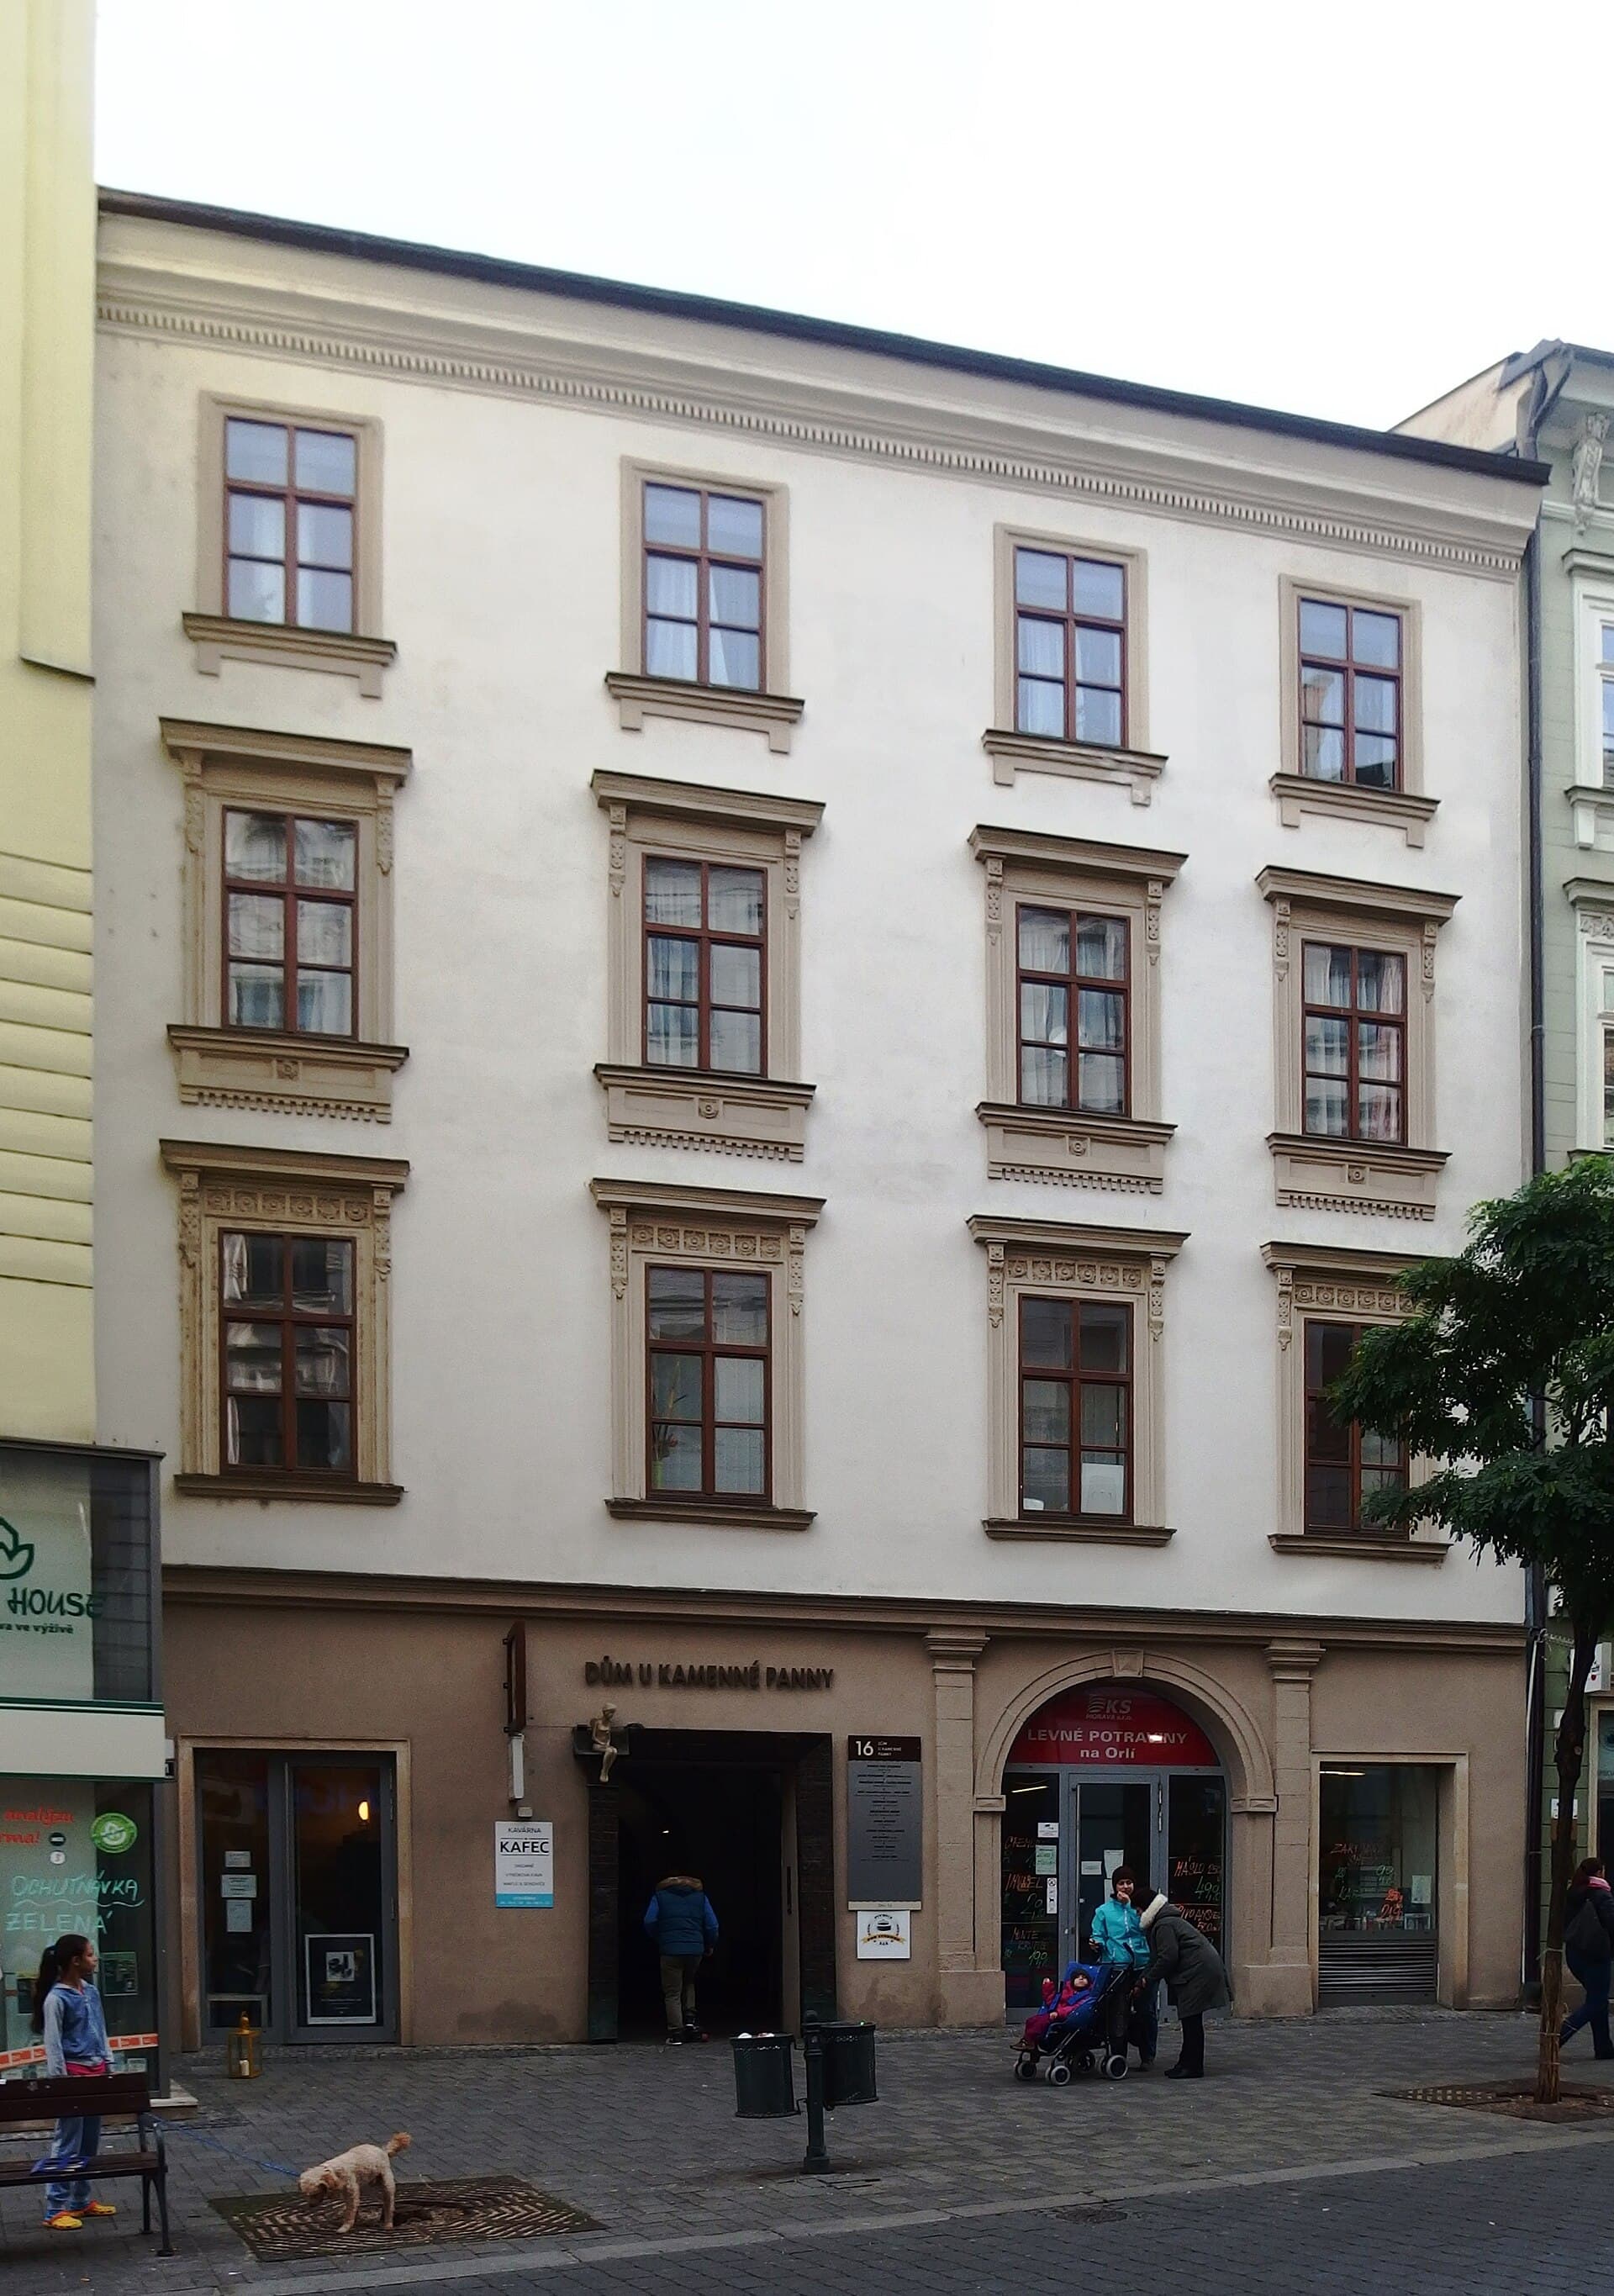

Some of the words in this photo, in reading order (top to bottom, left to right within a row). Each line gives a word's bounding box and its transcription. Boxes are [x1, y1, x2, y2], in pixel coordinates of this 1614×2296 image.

[7, 1587, 104, 1618] HOUSE
[584, 1655, 631, 1686] DŮM
[638, 1663, 652, 1686] U
[658, 1660, 760, 1689] KAMENNÉ
[766, 1666, 835, 1689] PANNY
[1027, 1728, 1084, 1742] LEVNÉ
[1089, 1730, 1188, 1744] POTRANY
[855, 1740, 874, 1756] 16
[1079, 1748, 1100, 1759] na
[1105, 1747, 1136, 1759] Orlí
[499, 1841, 550, 1854] KAFEC
[6, 1910, 113, 1934] ZELENÁ
